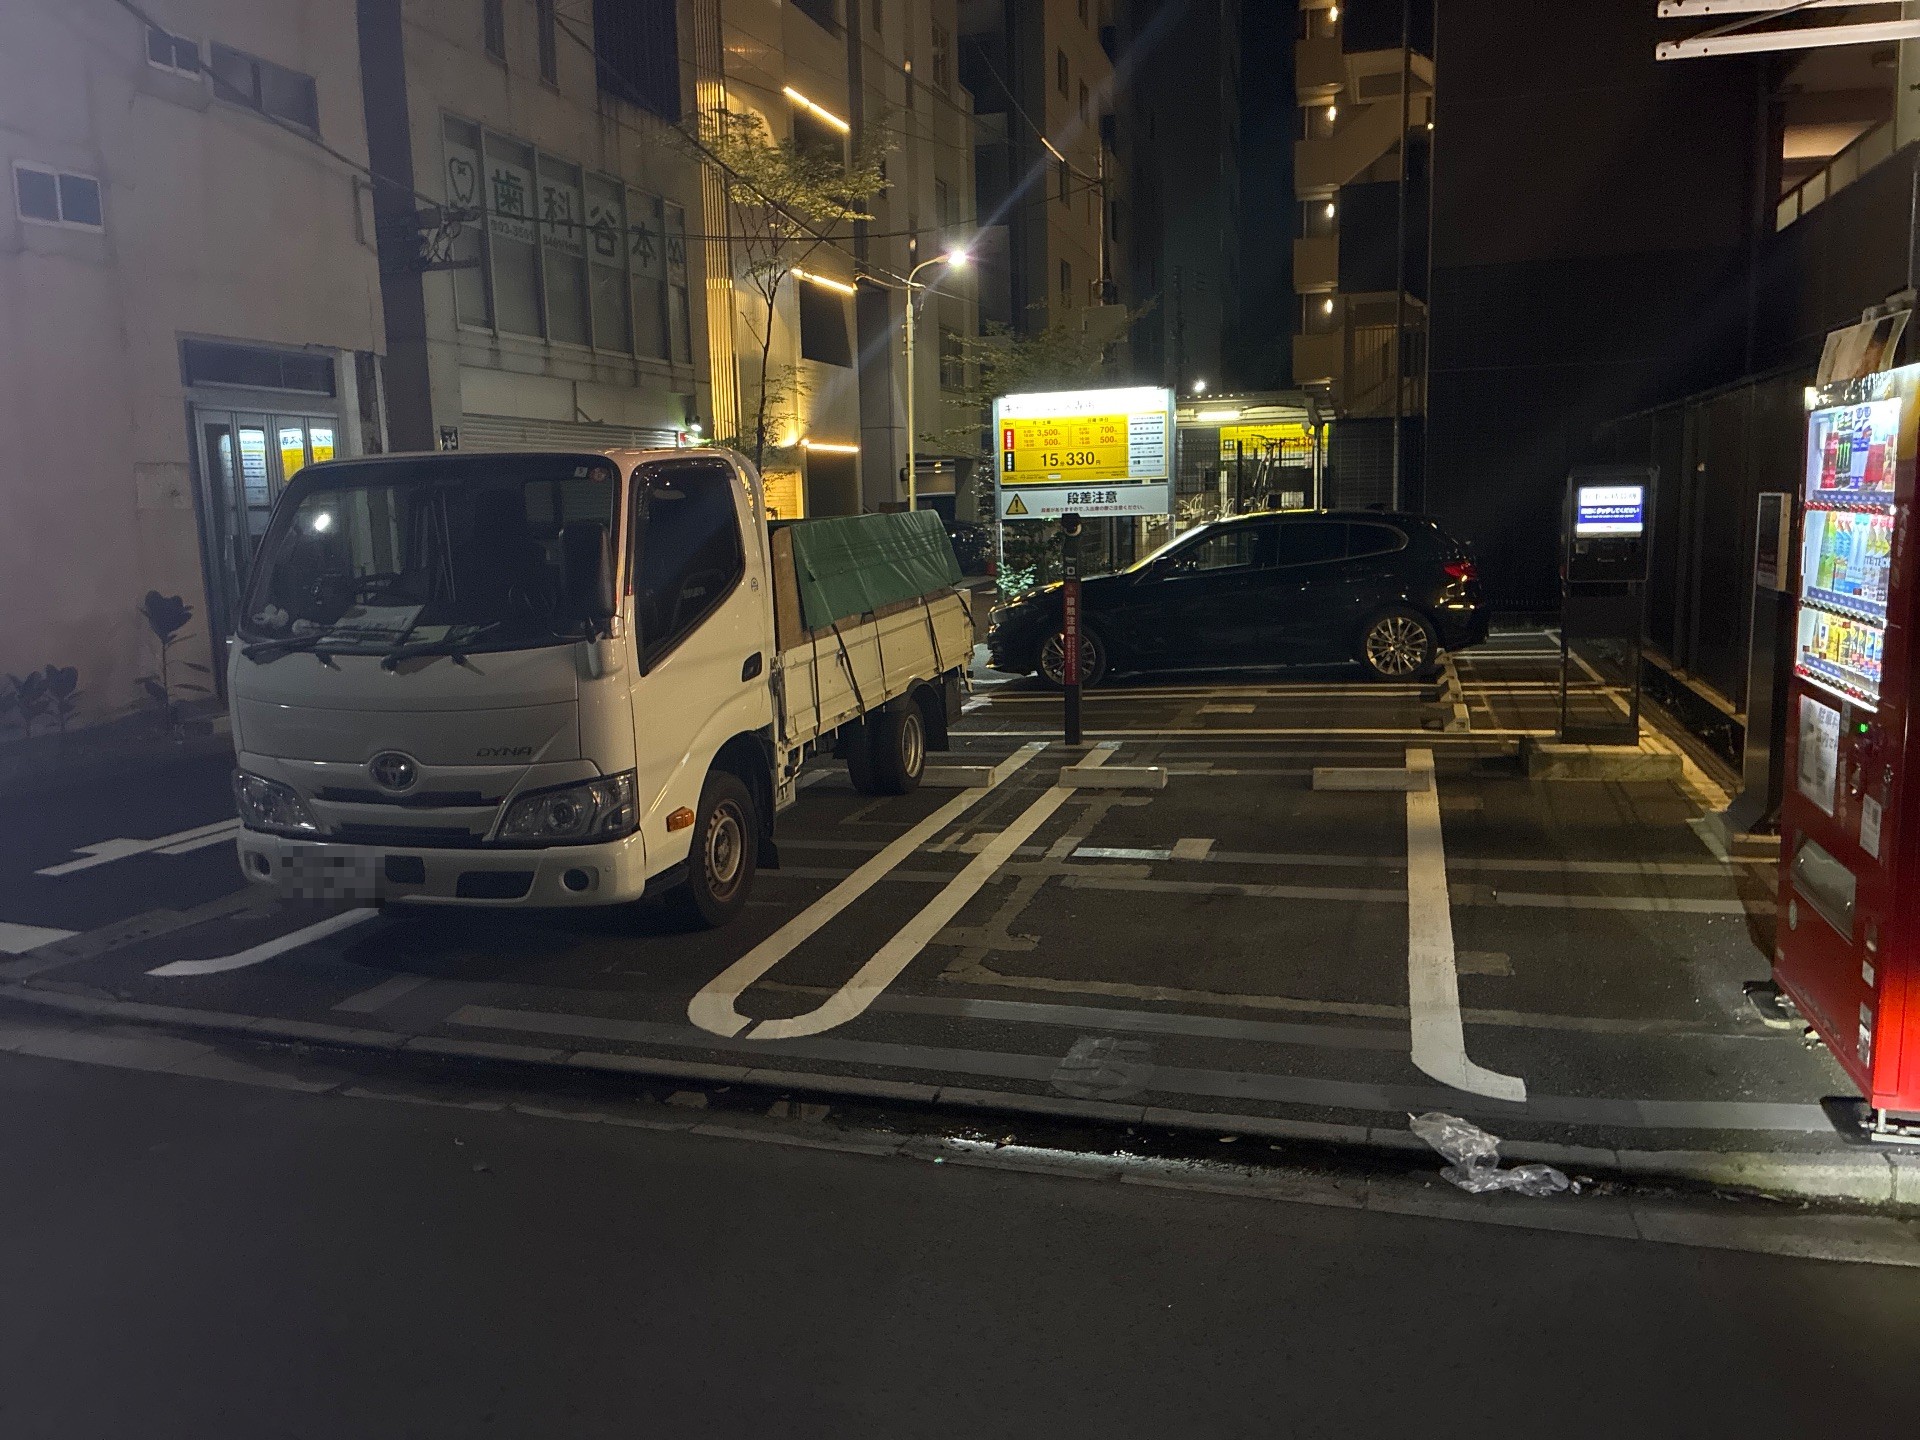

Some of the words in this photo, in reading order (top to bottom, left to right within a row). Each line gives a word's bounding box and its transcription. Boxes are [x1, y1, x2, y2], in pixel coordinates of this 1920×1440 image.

[1067, 491, 1118, 505] 段差注意
[477, 746, 532, 756] DYNA
